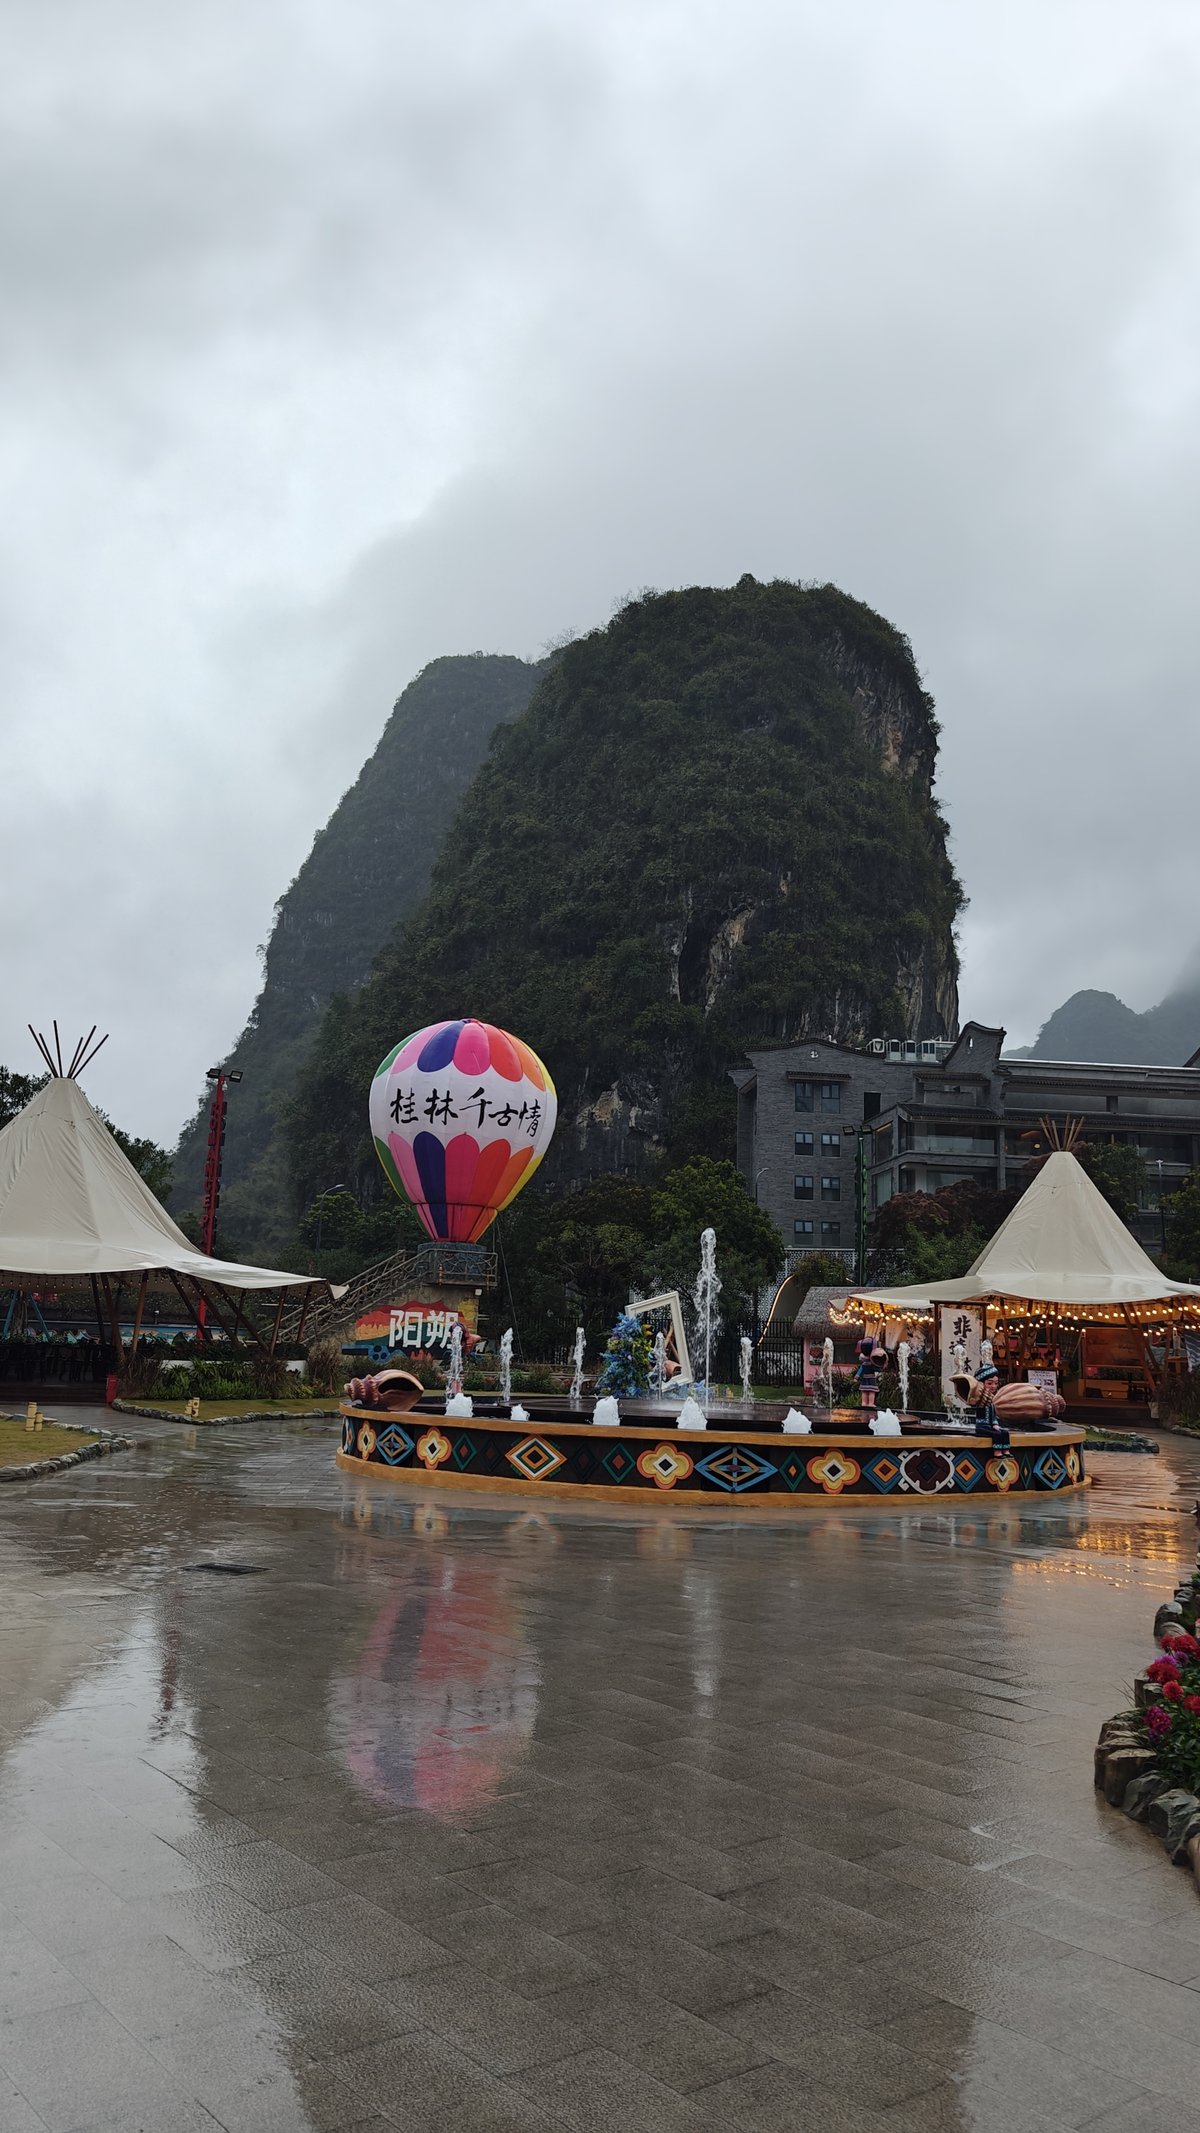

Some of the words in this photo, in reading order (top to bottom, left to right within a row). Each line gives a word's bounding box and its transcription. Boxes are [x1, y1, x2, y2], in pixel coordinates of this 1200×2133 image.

[390, 1087, 542, 1137] 桂林千古情
[388, 1309, 459, 1349] 阳朔
